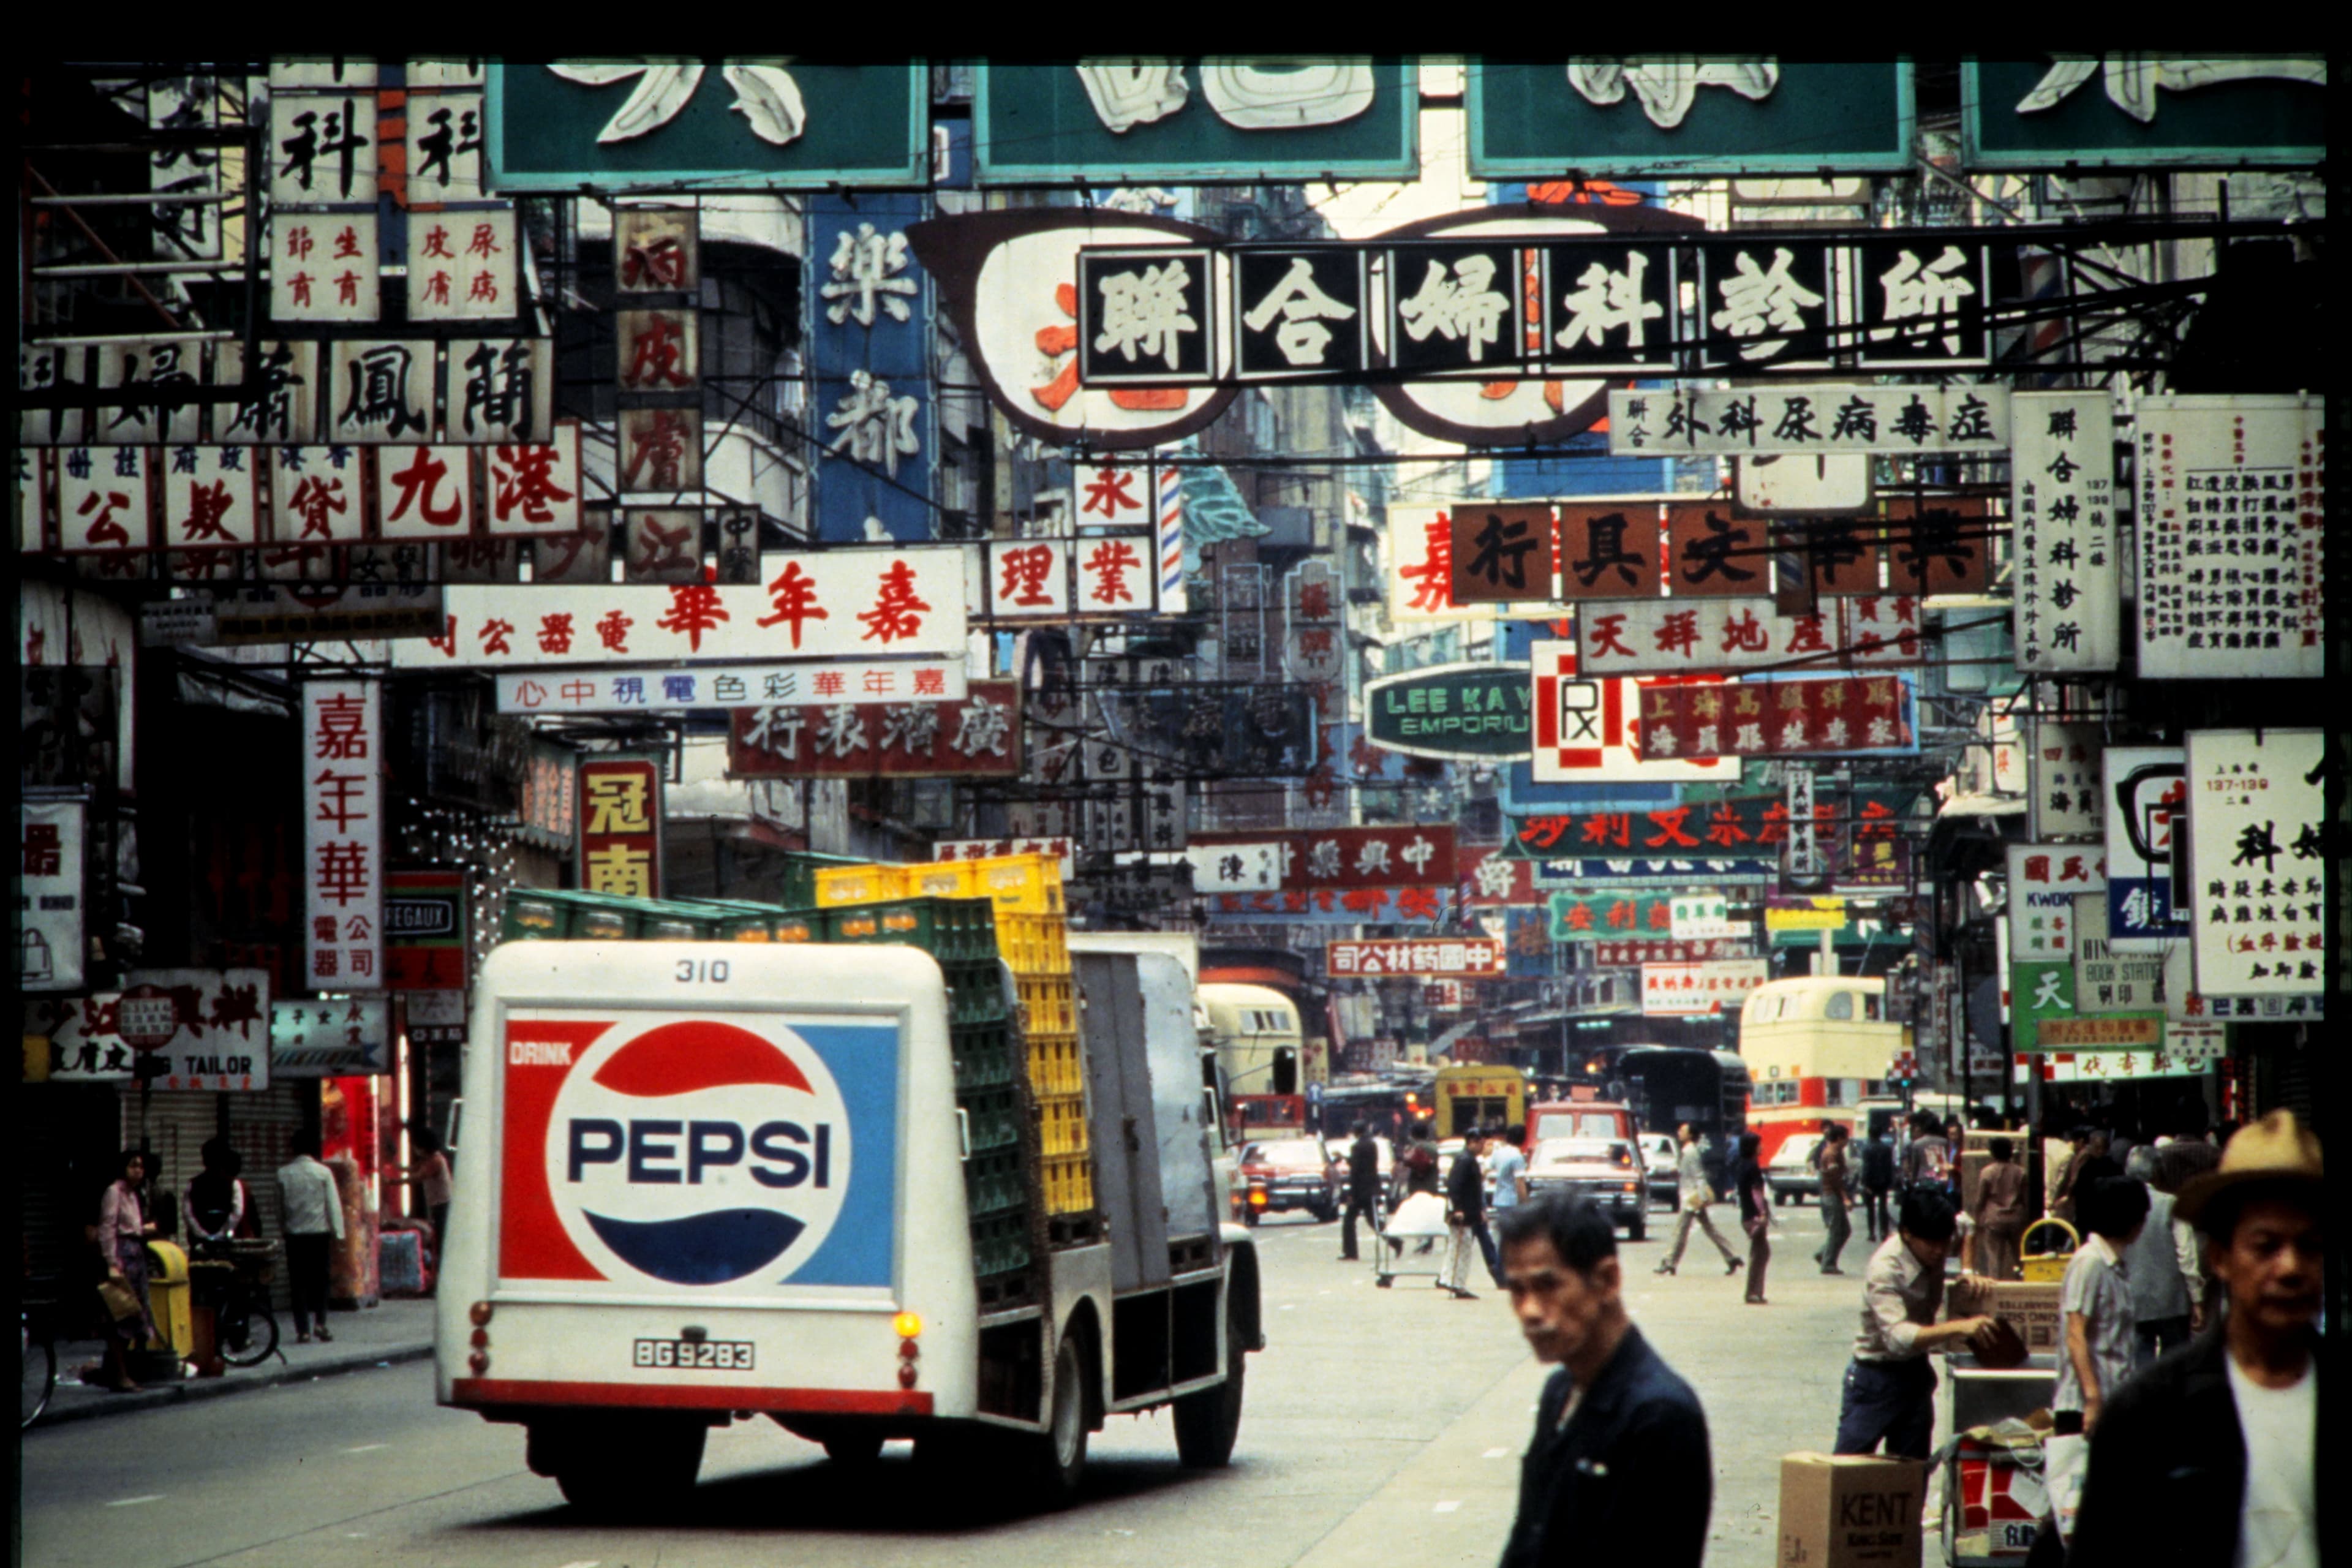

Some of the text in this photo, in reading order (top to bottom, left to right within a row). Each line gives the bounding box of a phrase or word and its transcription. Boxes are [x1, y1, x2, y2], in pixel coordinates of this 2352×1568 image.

[1095, 246, 1975, 371] 聯合婦科診所
[1664, 394, 1997, 448] 外科尿病毒症
[2046, 407, 2082, 655] 聯合婦科診所
[1588, 609, 1833, 659] 天祥地產
[514, 668, 946, 707] 嘉年華彩色電視中心
[1385, 687, 1448, 714] LEE
[1400, 714, 1530, 735] EMPORIU
[314, 693, 368, 907] 嘉年華
[2024, 854, 2106, 884] 國民
[675, 959, 731, 983] 310
[2031, 970, 2073, 1011] 天
[186, 1056, 252, 1074] TAILOR
[508, 1041, 573, 1066] DRINK
[567, 1117, 831, 1189] PEPSI
[1841, 1491, 1912, 1527] KENT
